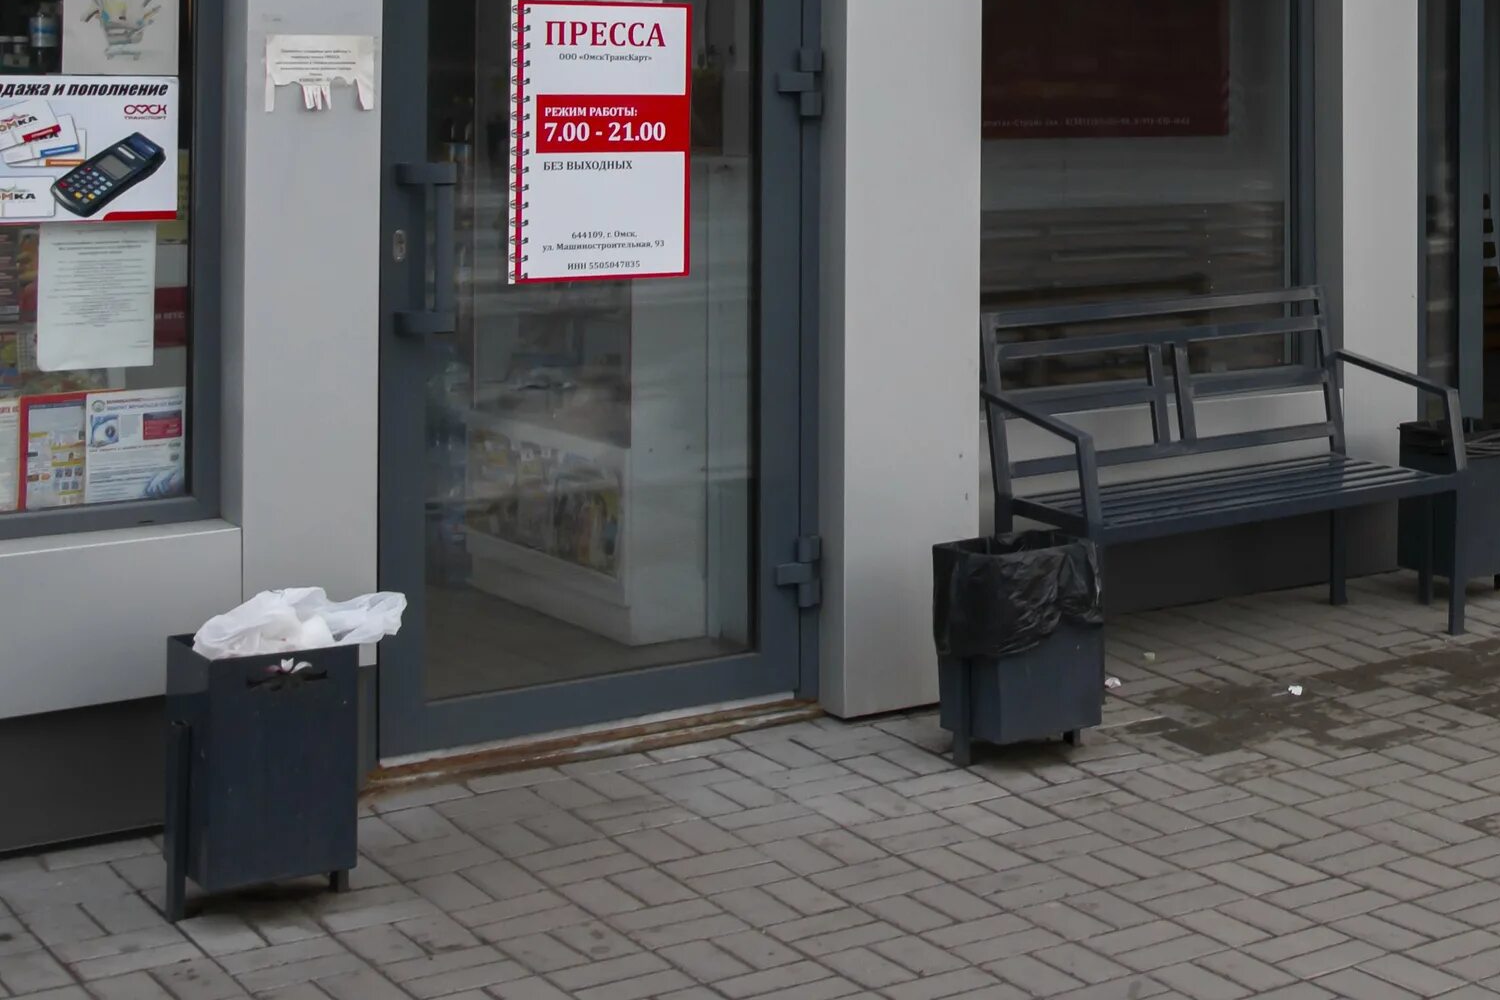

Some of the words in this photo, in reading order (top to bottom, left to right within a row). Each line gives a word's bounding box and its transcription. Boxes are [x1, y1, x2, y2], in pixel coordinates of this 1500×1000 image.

[545, 21, 666, 47] ПРЕССА
[558, 53, 577, 61] ООО
[53, 84, 63, 96] и
[67, 83, 168, 97] пополнение
[544, 106, 586, 117] РЕЖИМ
[589, 107, 638, 117] РАБОТЫ:
[544, 122, 590, 142] 7.00
[608, 121, 666, 141] 21.00
[543, 161, 564, 171] БЕЗ
[566, 160, 633, 171] ВЫХОДНЫХ
[654, 240, 665, 248] 93
[567, 262, 587, 270] ИНН
